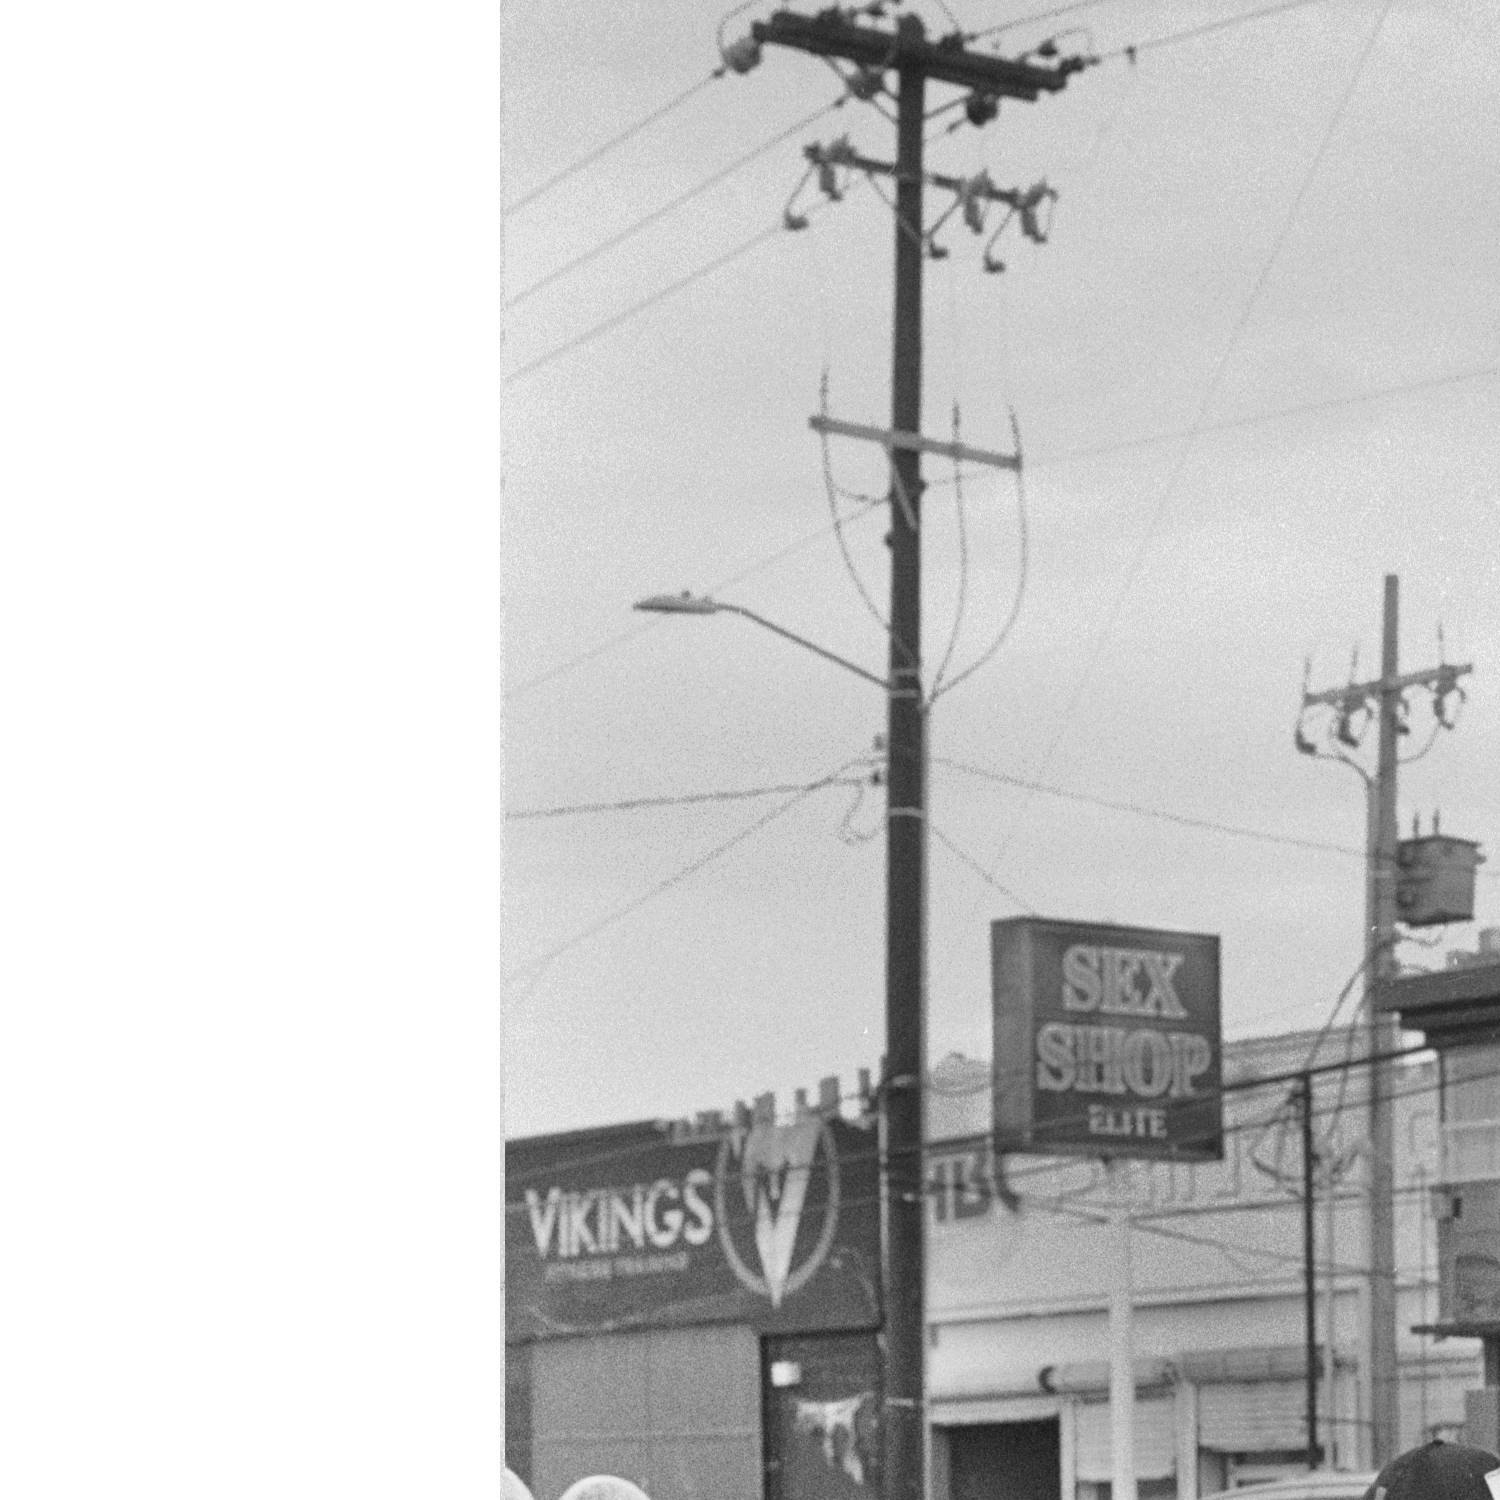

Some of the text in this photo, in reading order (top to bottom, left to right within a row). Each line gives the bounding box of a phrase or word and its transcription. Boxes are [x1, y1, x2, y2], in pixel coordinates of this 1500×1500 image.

[1061, 944, 1188, 1019] SEX
[1036, 1022, 1212, 1098] SHOP
[1088, 1105, 1167, 1138] ELITE
[524, 1169, 714, 1259] VIKINGS
